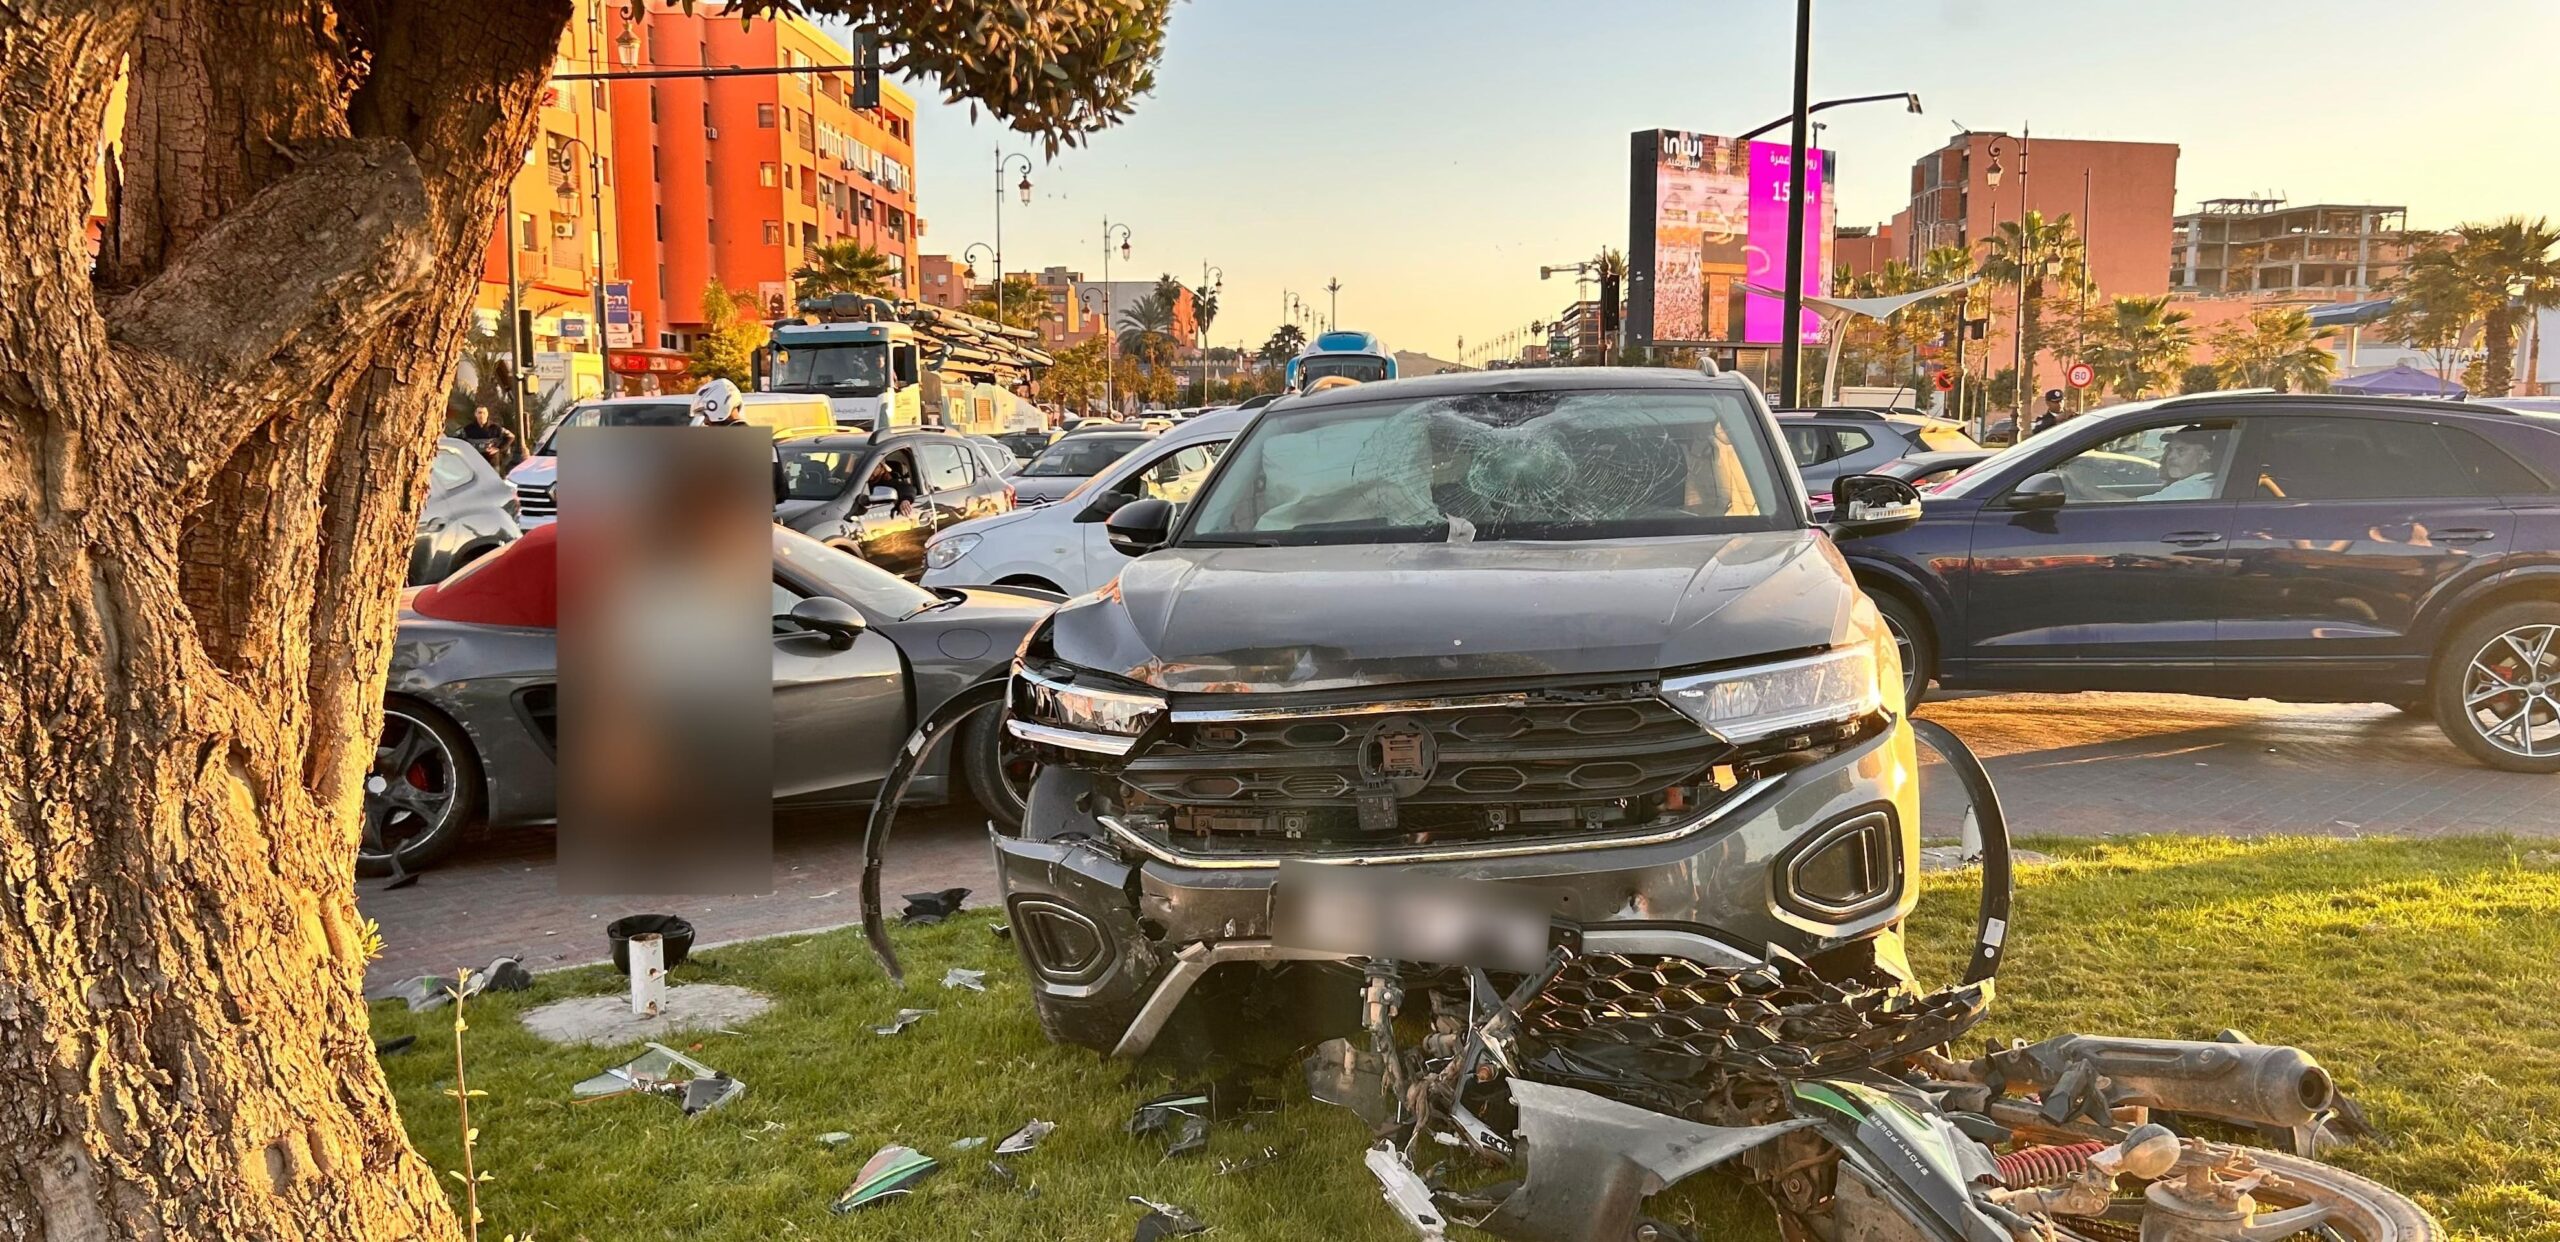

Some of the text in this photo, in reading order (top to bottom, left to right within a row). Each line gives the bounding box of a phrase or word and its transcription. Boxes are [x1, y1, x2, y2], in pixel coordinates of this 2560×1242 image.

[1663, 136, 1703, 158] inwi
[2074, 371, 2087, 381] 60
[1870, 1115, 1929, 1176] SPORT POWER
